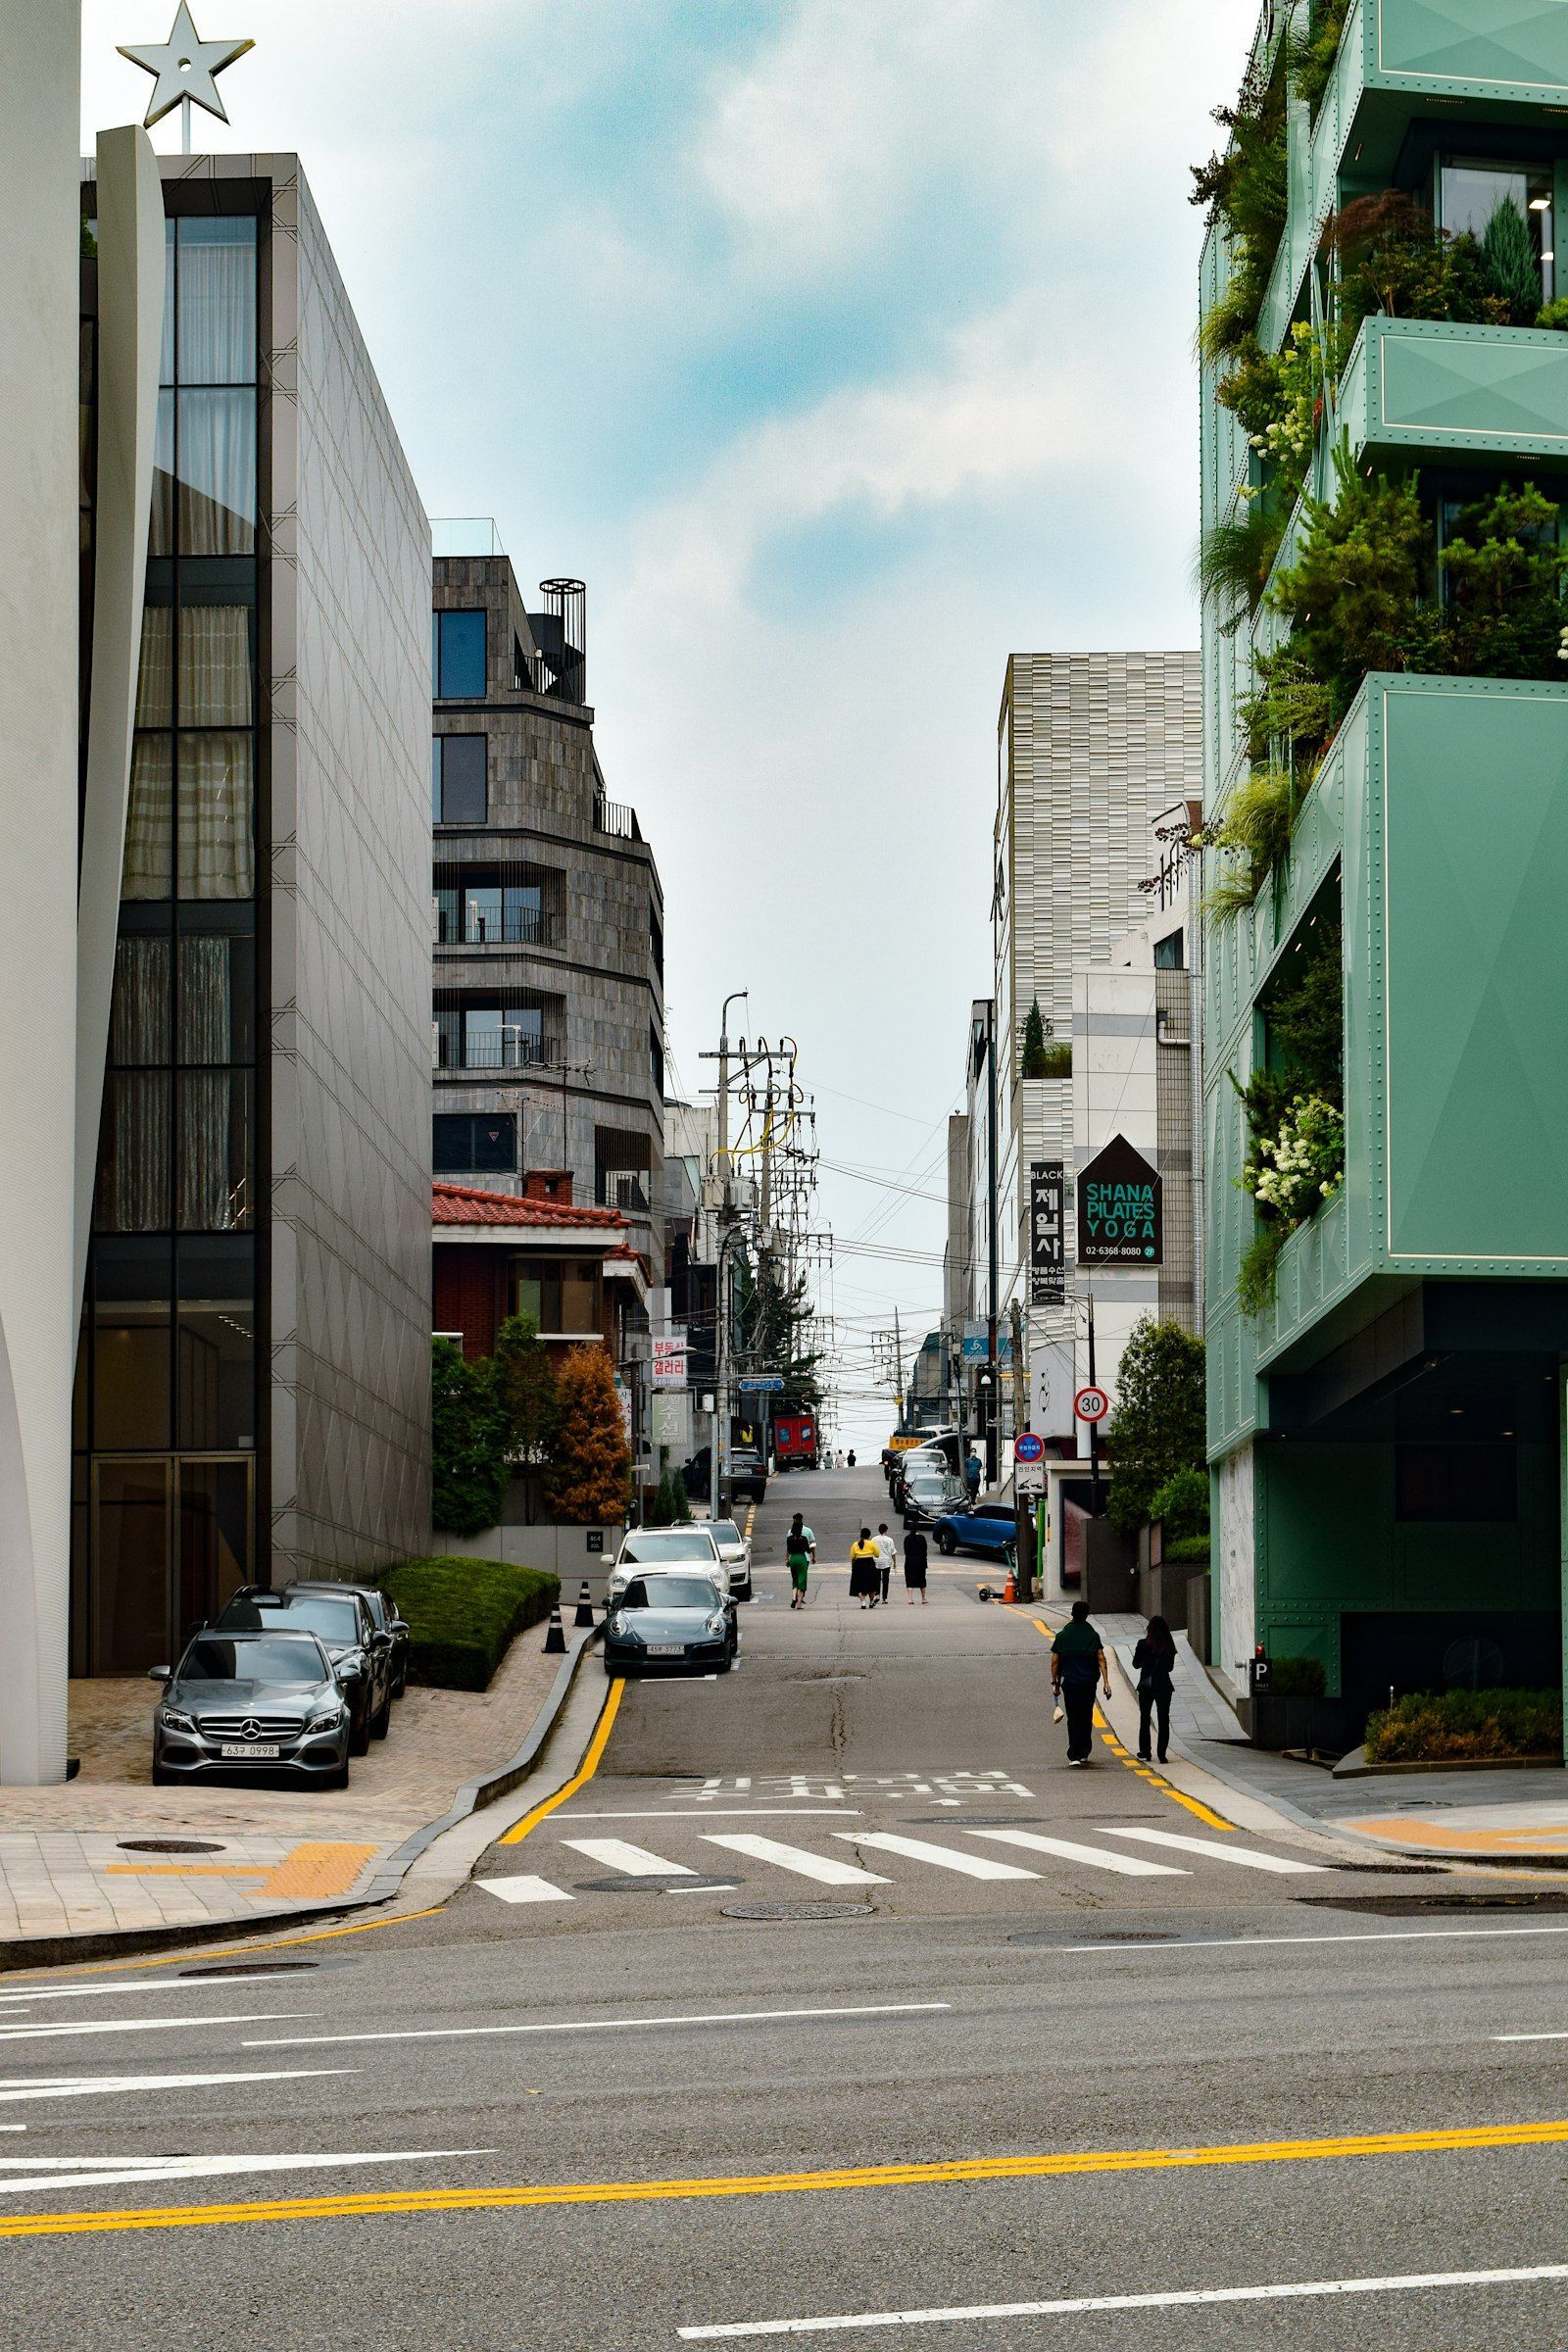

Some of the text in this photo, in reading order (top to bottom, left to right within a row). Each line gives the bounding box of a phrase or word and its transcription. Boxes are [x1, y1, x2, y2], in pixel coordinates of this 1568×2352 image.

[1031, 1170, 1063, 1180] BLACK
[1086, 1183, 1153, 1201] SHANA
[1086, 1201, 1154, 1220] PILATES
[1035, 1189, 1061, 1260] 제일사
[1086, 1220, 1154, 1239] YOGA
[655, 1359, 684, 1375] 갤러리
[1082, 1396, 1101, 1412] 30
[1255, 1663, 1268, 1681] P
[226, 1745, 274, 1755] 63구 0998
